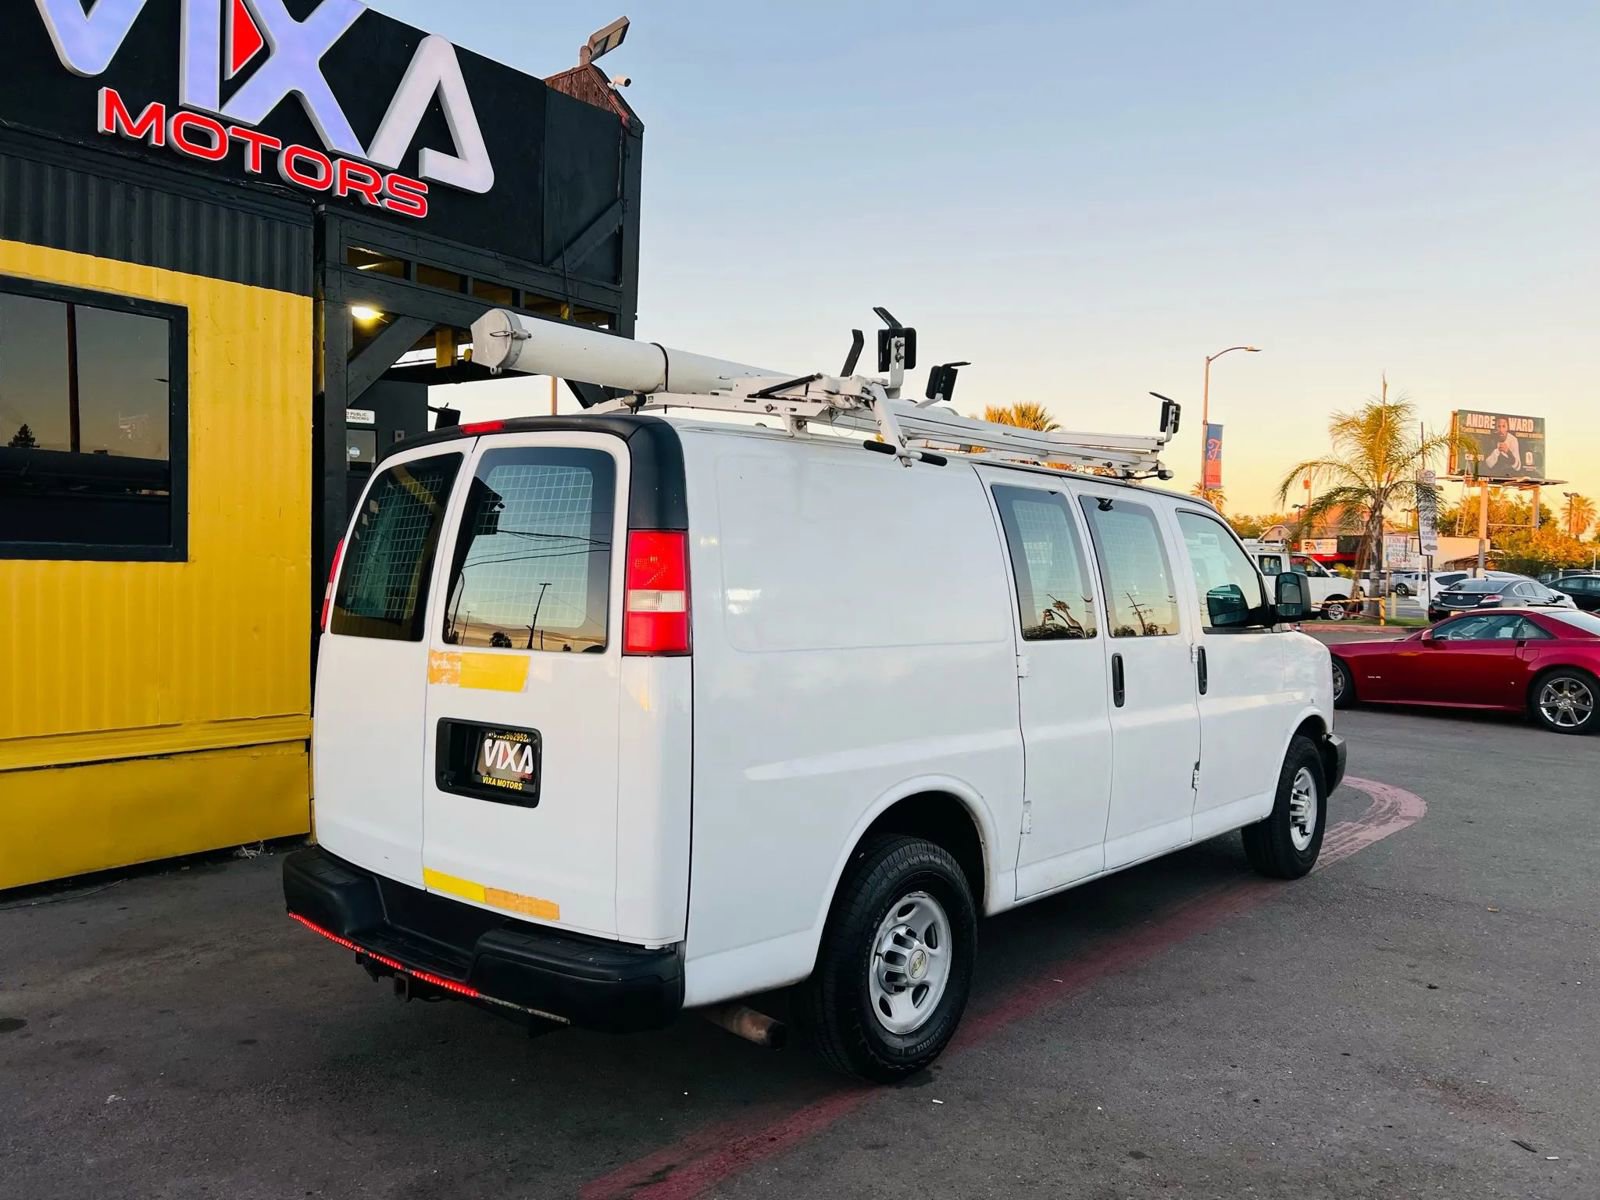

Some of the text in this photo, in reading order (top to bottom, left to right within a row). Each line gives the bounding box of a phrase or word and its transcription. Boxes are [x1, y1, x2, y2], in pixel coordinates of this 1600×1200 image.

[97, 86, 429, 219] MOTORS
[1466, 413, 1496, 429] ANDRE
[1508, 417, 1534, 432] WARD
[484, 738, 534, 774] VIXA
[482, 776, 523, 791] VIXA MOTORS
